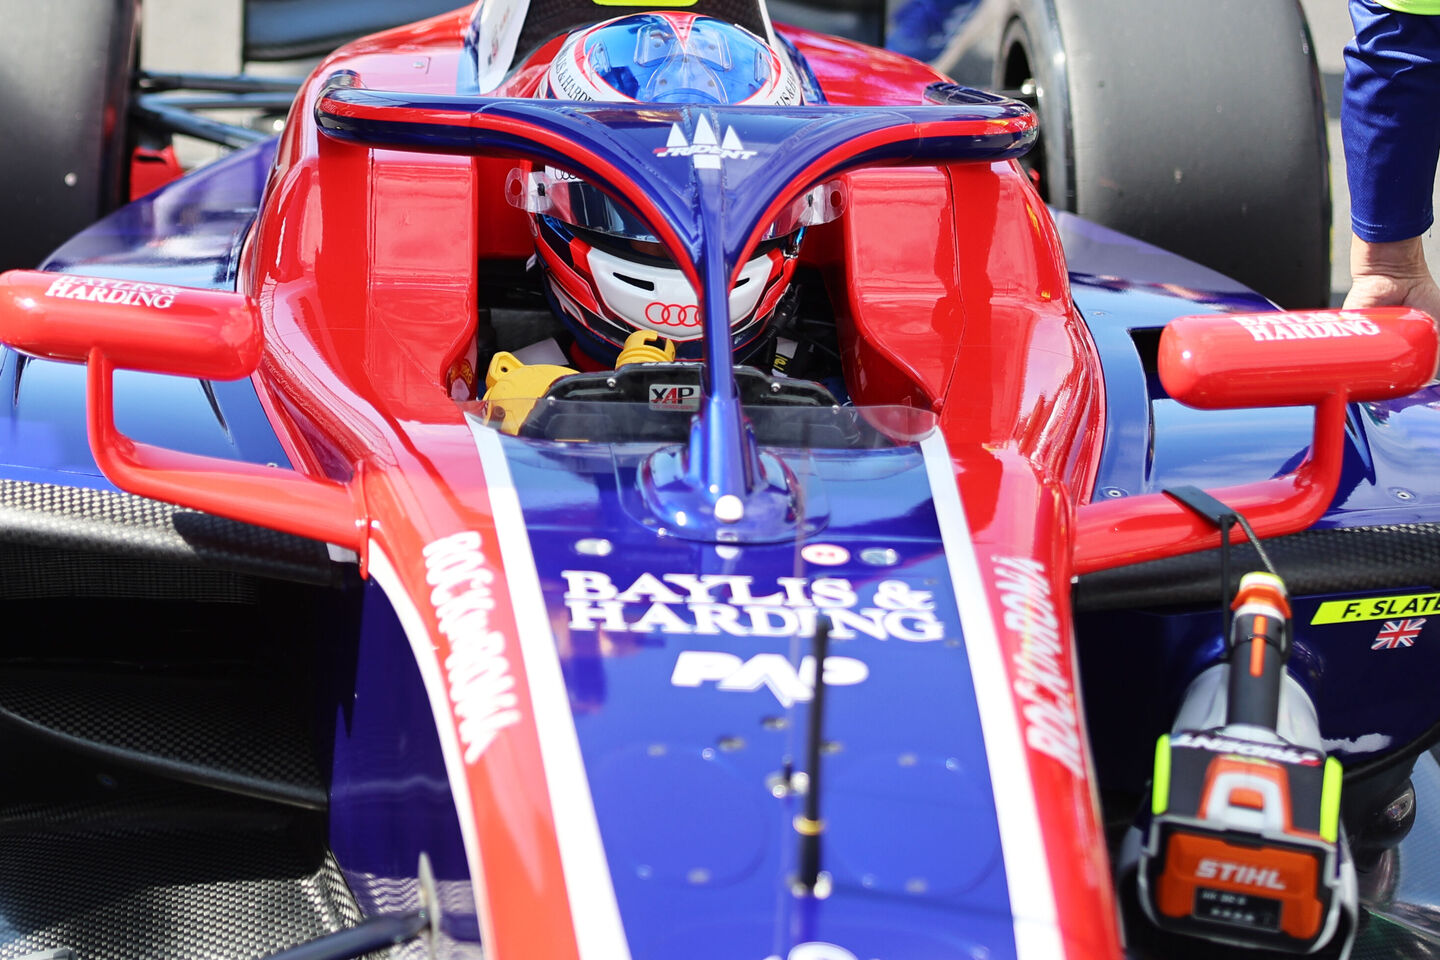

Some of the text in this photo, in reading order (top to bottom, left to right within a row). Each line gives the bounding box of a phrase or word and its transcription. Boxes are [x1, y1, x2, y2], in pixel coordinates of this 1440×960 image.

[652, 144, 758, 160] TRIDENT
[45, 281, 176, 309] HARDING
[1244, 320, 1381, 341] HARDING
[651, 387, 695, 404] XAP
[560, 569, 937, 611] BAYLIS &
[564, 598, 945, 643] HARDING
[1342, 602, 1361, 619] F.
[1195, 858, 1287, 890] STIHL
